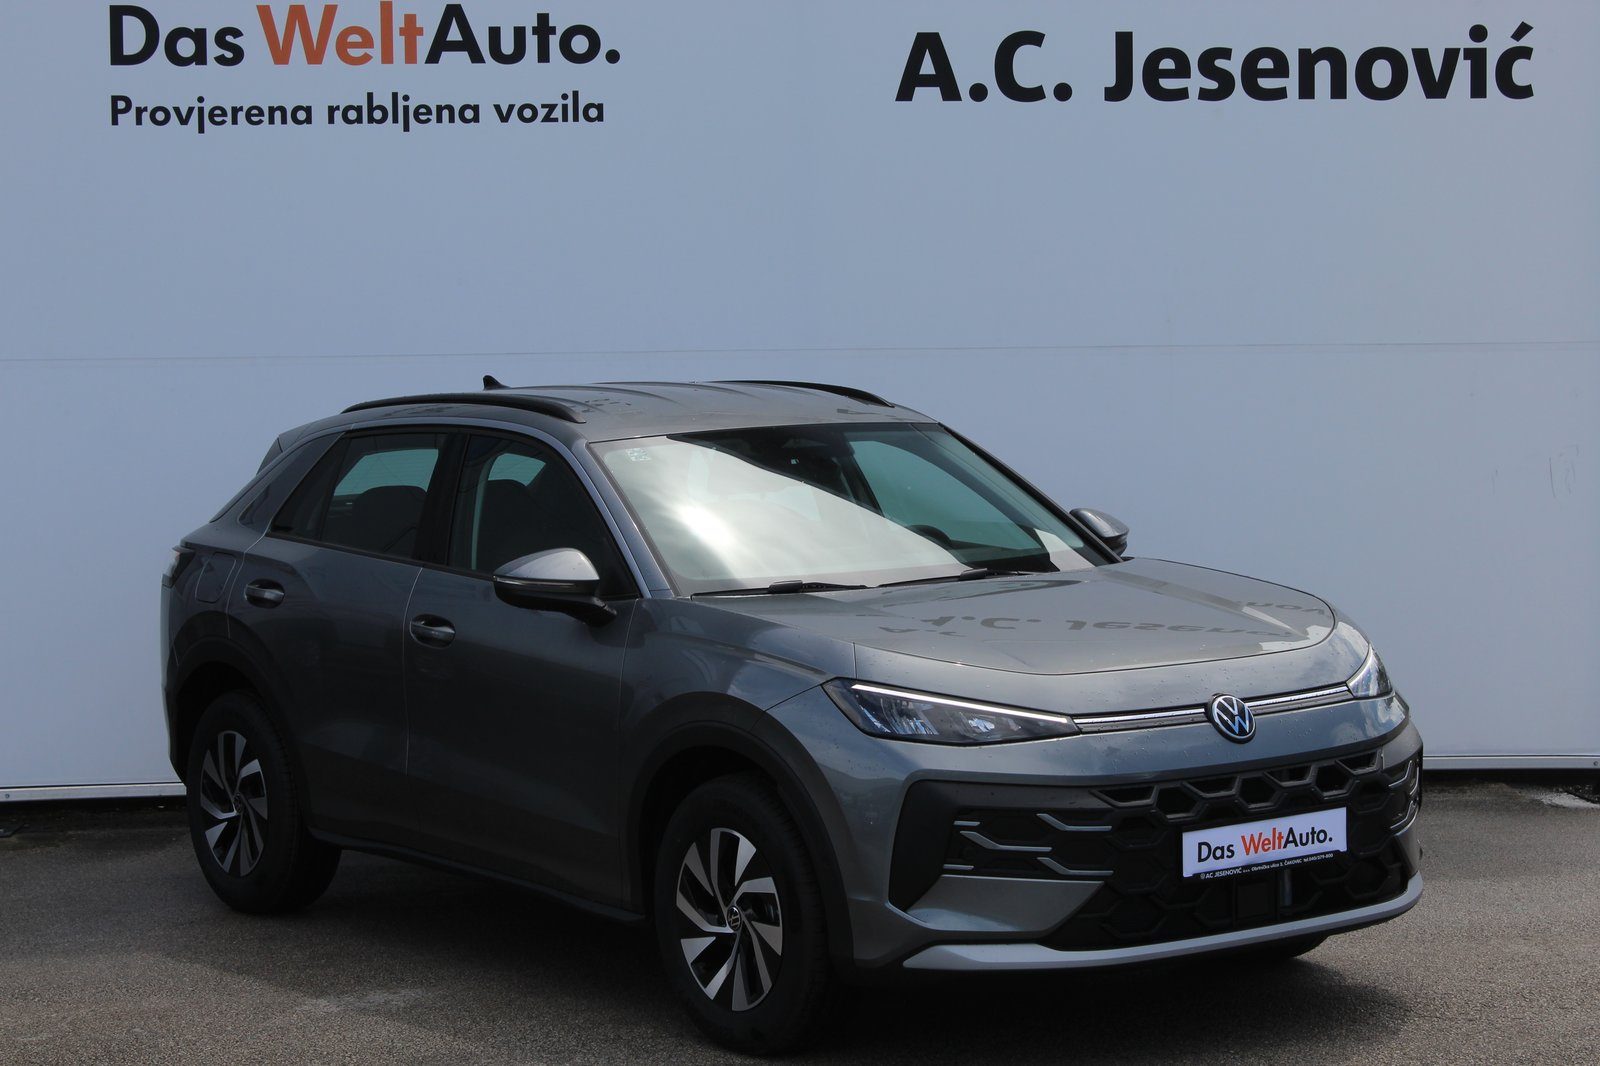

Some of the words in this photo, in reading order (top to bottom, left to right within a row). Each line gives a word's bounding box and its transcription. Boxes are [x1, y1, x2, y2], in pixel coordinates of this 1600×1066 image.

[109, 5, 244, 67] Das
[256, 1, 620, 66] WeltAuto.
[895, 30, 1072, 102] A.C.
[1104, 21, 1534, 102] Jesenović
[111, 95, 312, 134] Provjerena
[328, 92, 480, 132] rabljena
[493, 90, 604, 124] vozila
[1197, 841, 1235, 863] Das
[1241, 827, 1333, 856] WeltAuto.
[1214, 867, 1242, 878] JESENOVIĆ
